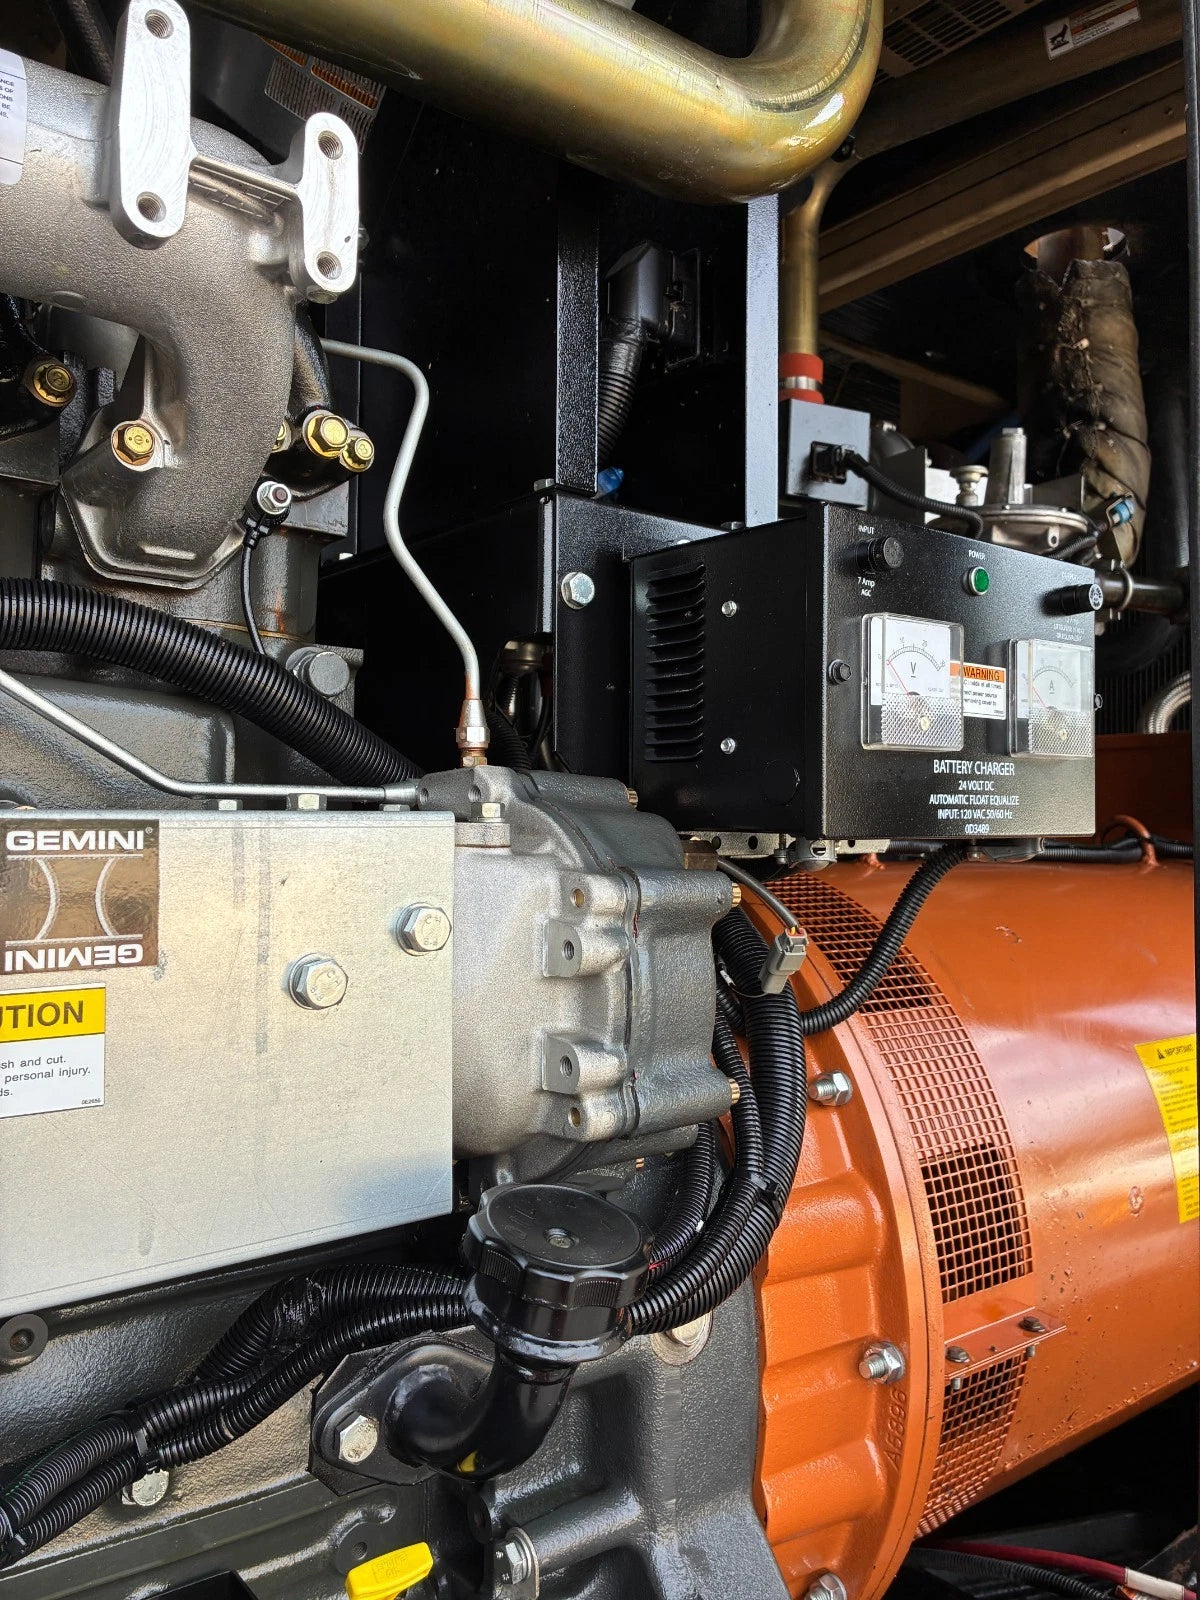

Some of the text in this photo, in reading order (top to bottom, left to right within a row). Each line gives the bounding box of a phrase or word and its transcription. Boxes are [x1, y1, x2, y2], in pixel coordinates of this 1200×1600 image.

[858, 525, 875, 535] INPUT
[968, 550, 986, 560] POWER
[862, 578, 876, 588] Amp
[861, 589, 872, 597] AGC
[910, 661, 917, 674] V
[963, 666, 1000, 681] WARNING
[933, 759, 1015, 776] BATTERY CHARGER
[958, 780, 995, 791] 24 VOLT DC
[929, 794, 1020, 806] AUTOMATIC FLOAT EQUALIZE
[937, 809, 1013, 820] INPUT: 120 VAC 50/60 Hz
[6, 830, 144, 851] GEMINI
[5, 943, 143, 972] GEMINI
[20, 1057, 41, 1068] and
[46, 1055, 66, 1065] cut.
[4, 1066, 91, 1084] personal injury.
